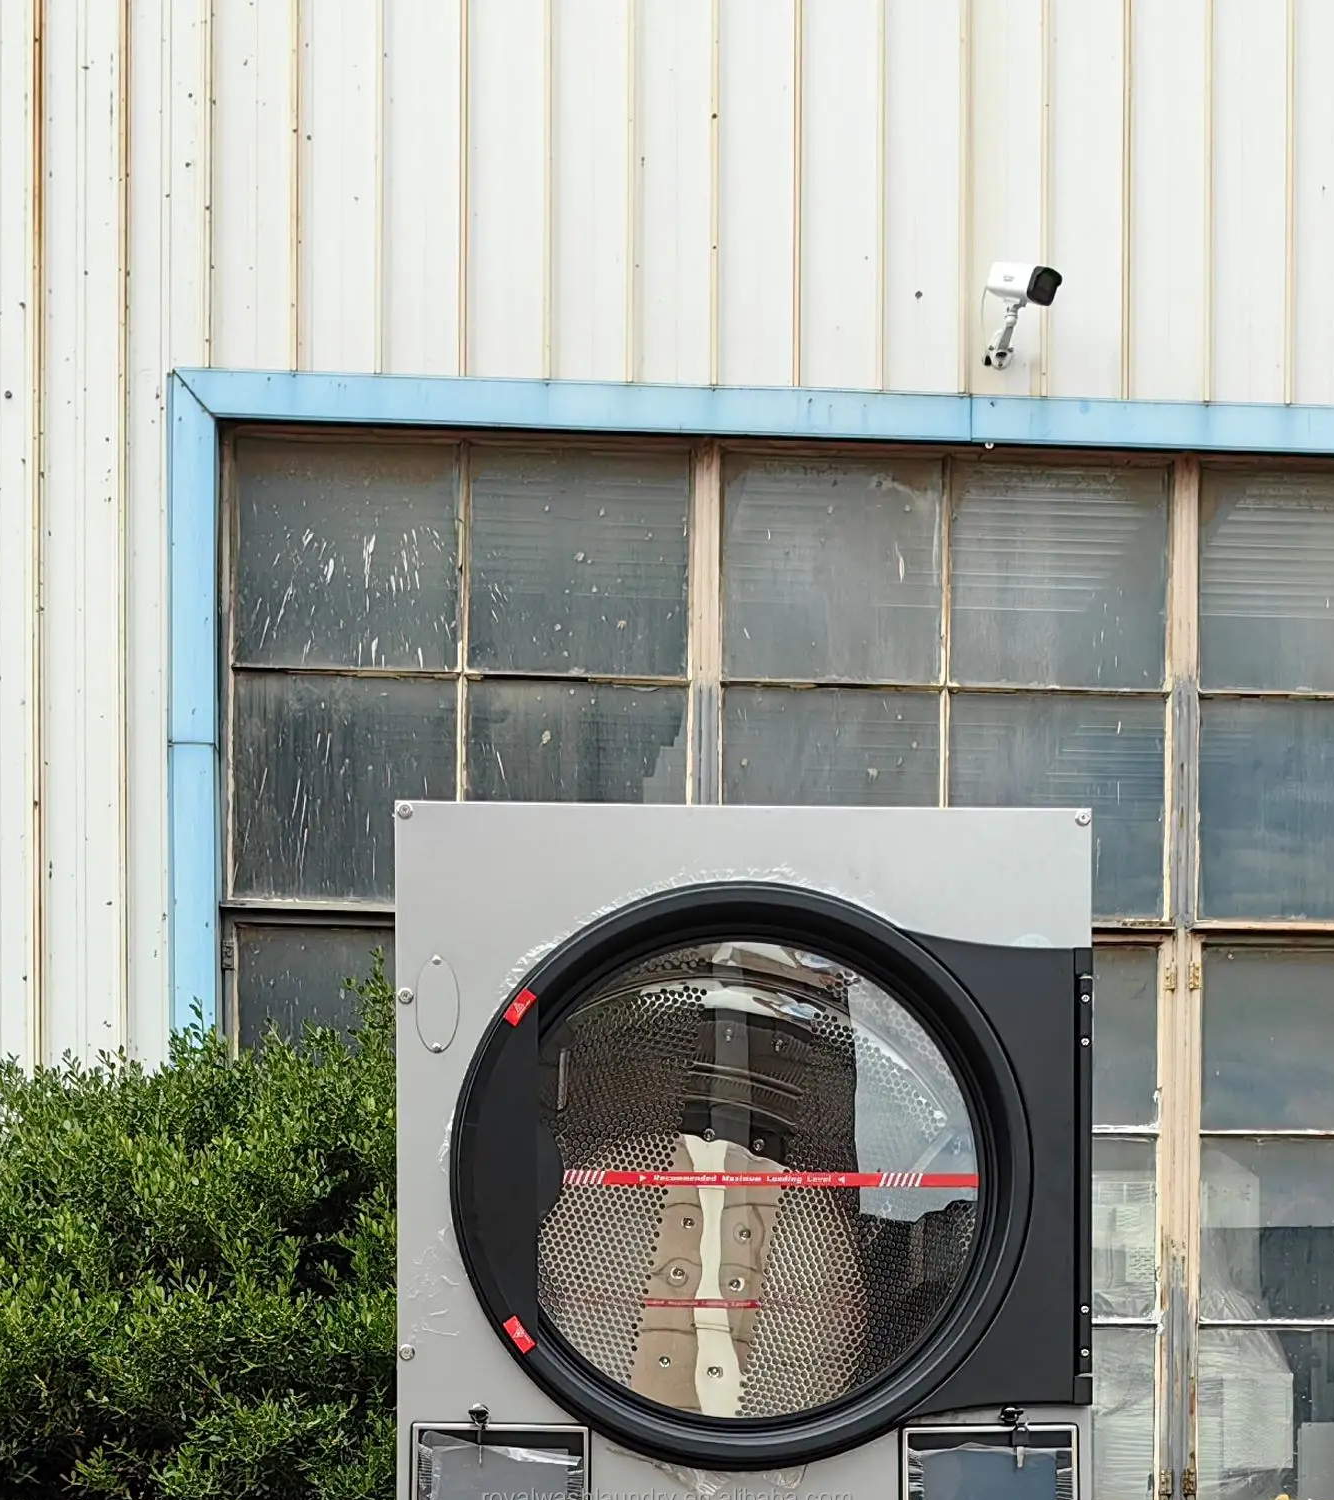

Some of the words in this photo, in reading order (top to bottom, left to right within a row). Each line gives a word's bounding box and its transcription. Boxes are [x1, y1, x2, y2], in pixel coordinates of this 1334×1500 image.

[653, 1174, 717, 1182] Recommended
[722, 1174, 762, 1182] Maximum
[767, 1175, 803, 1184] Loading
[807, 1175, 832, 1183] Level
